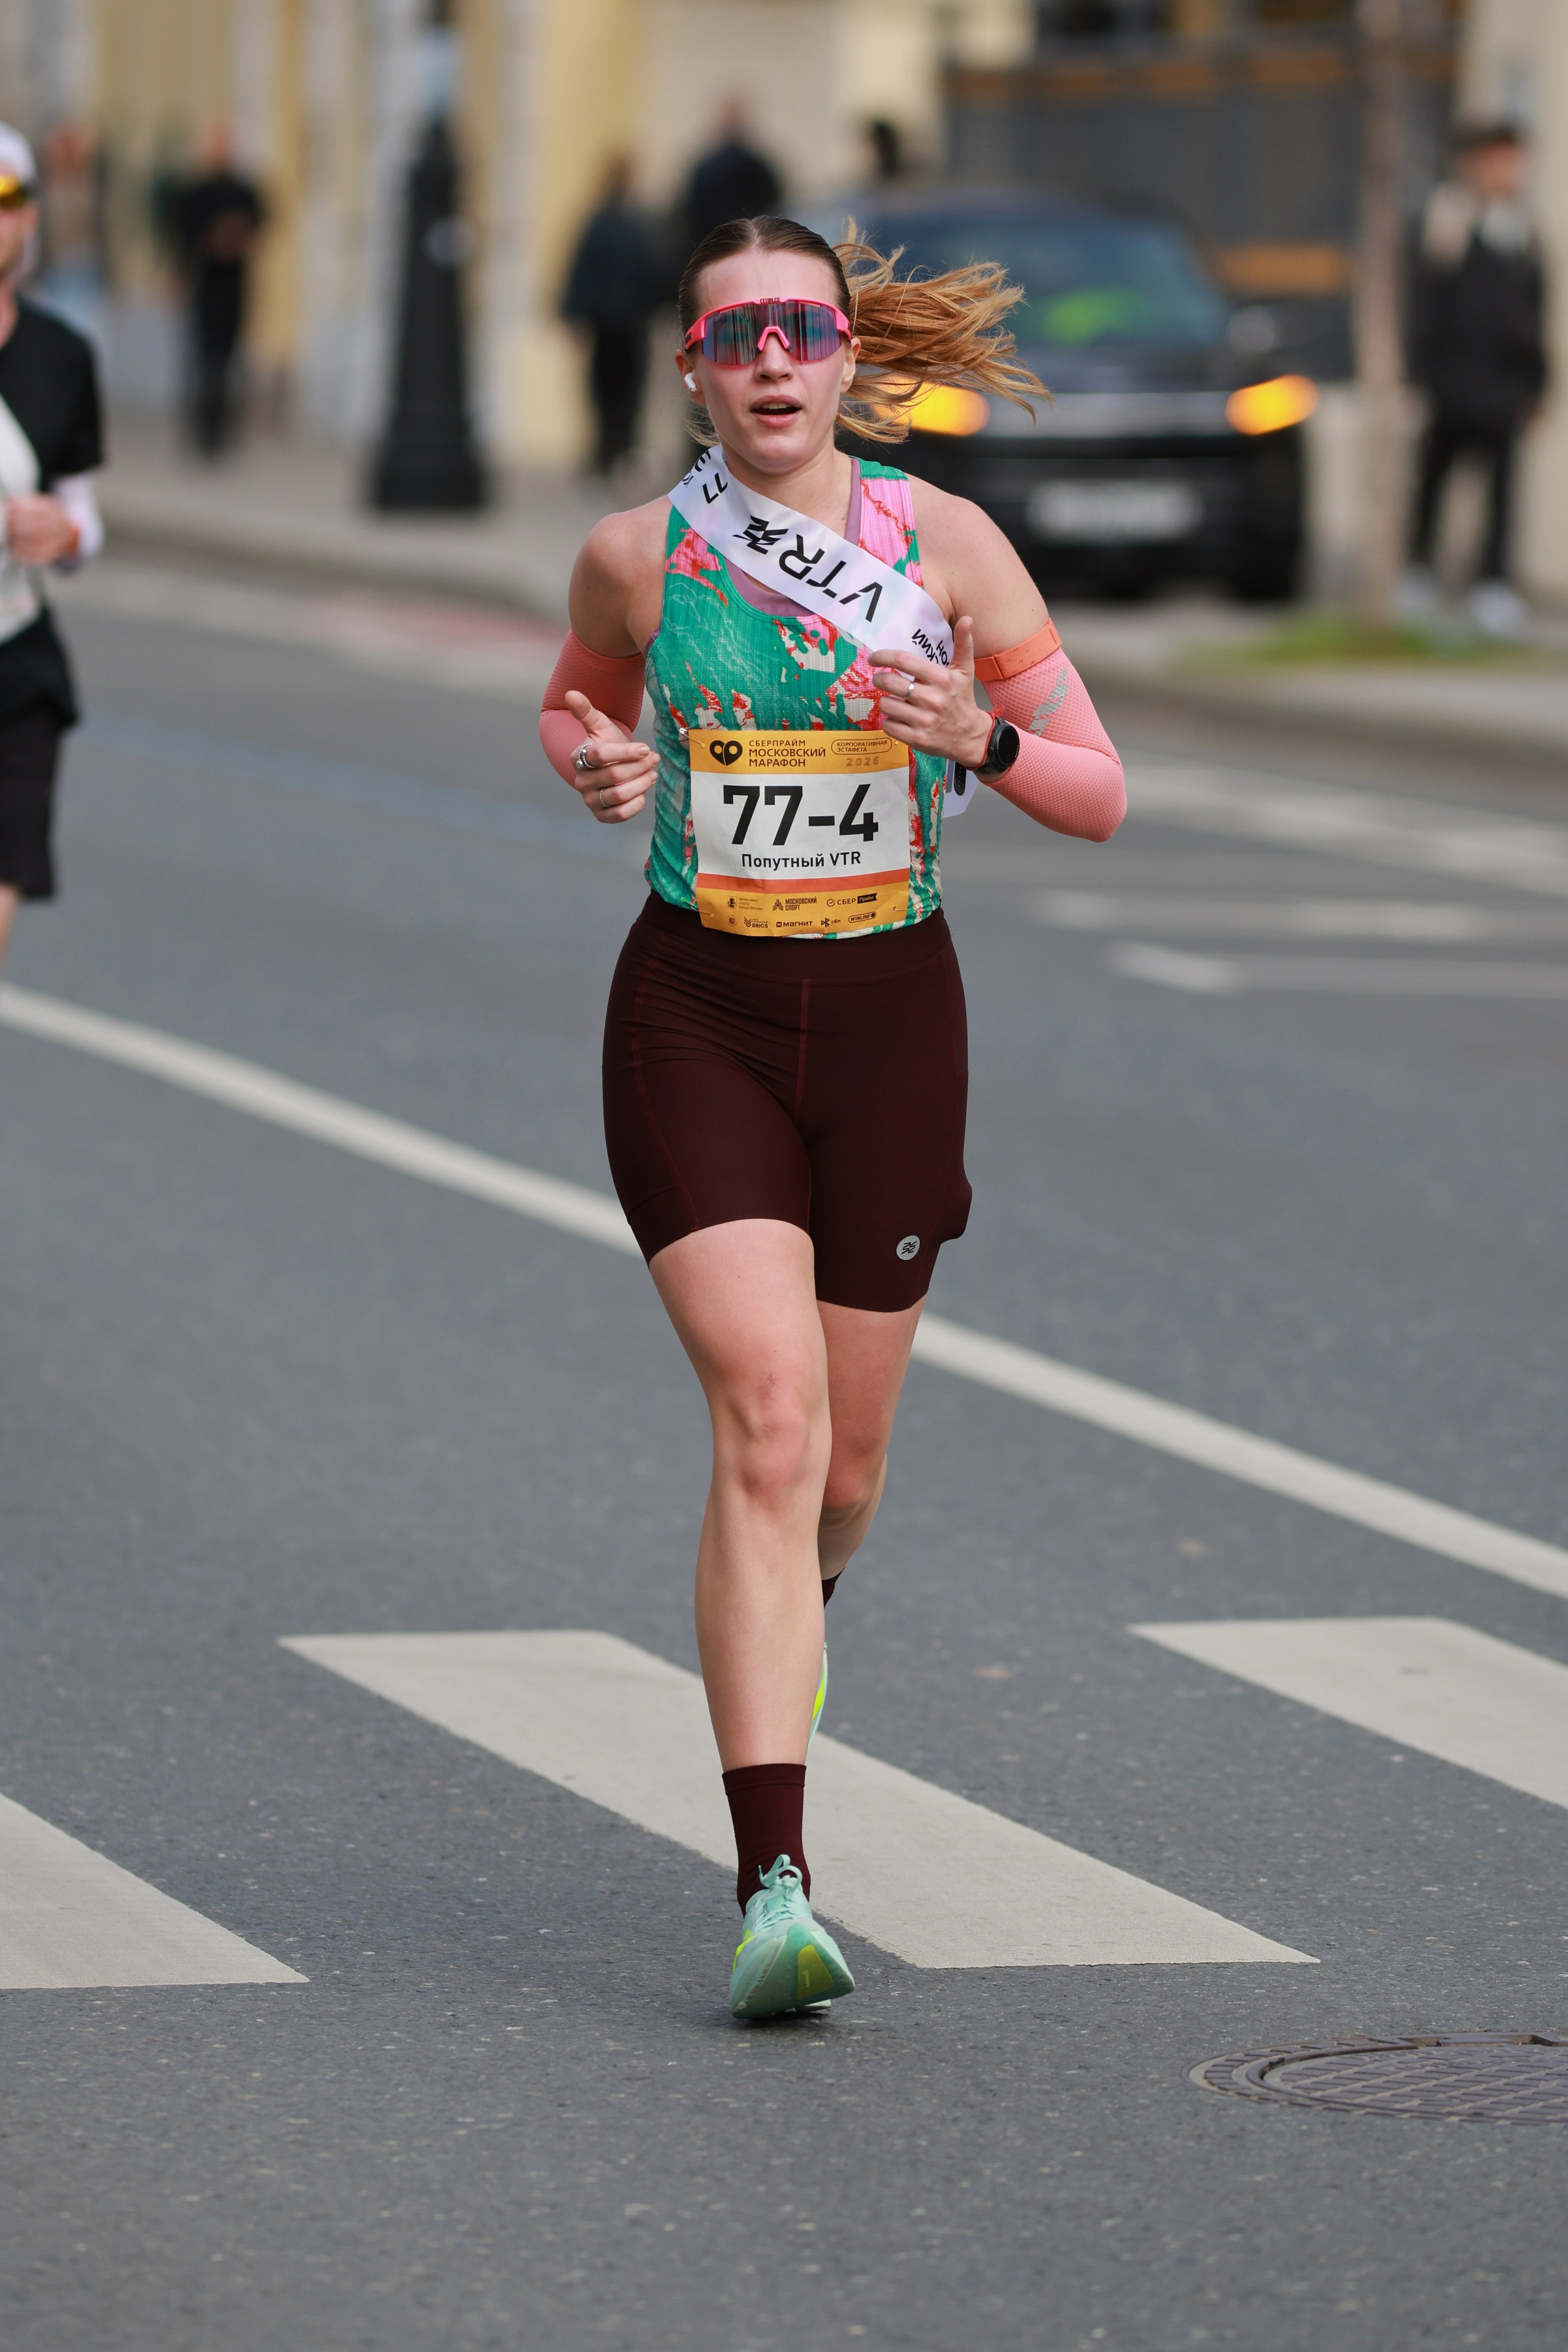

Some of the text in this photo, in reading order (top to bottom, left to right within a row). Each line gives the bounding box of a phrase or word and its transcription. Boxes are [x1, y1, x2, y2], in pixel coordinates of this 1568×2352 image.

[703, 472, 728, 504] 77
[779, 534, 883, 623] VTR
[748, 747, 826, 757] МОСКОВСКИЙ
[846, 756, 880, 767] 2026
[748, 758, 805, 767] МАРАФОН
[723, 783, 879, 846] 77-4
[741, 851, 861, 871] Попутный VTR
